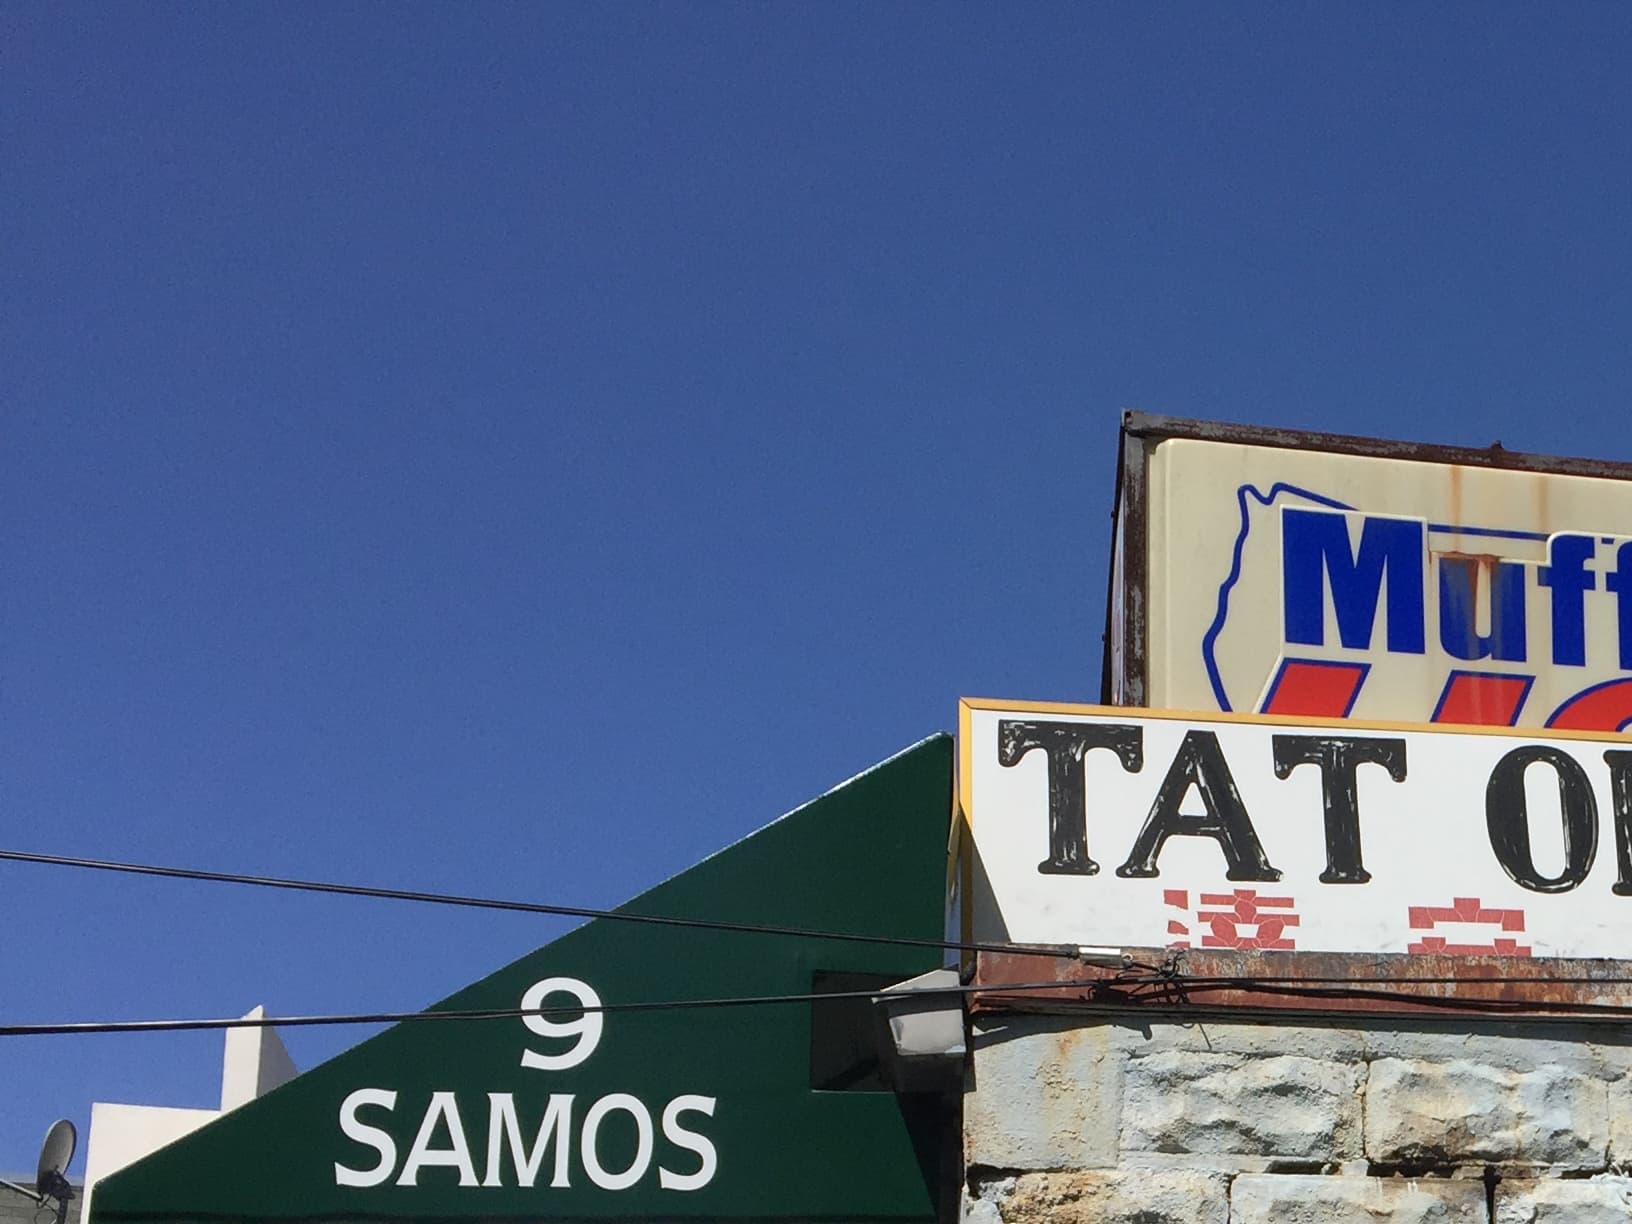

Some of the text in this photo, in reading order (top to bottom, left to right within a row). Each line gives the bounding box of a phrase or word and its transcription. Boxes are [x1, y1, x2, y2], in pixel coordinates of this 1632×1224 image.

[998, 719, 1407, 885] TAT
[519, 976, 604, 1071] 9
[334, 1088, 717, 1191] SAMOS
